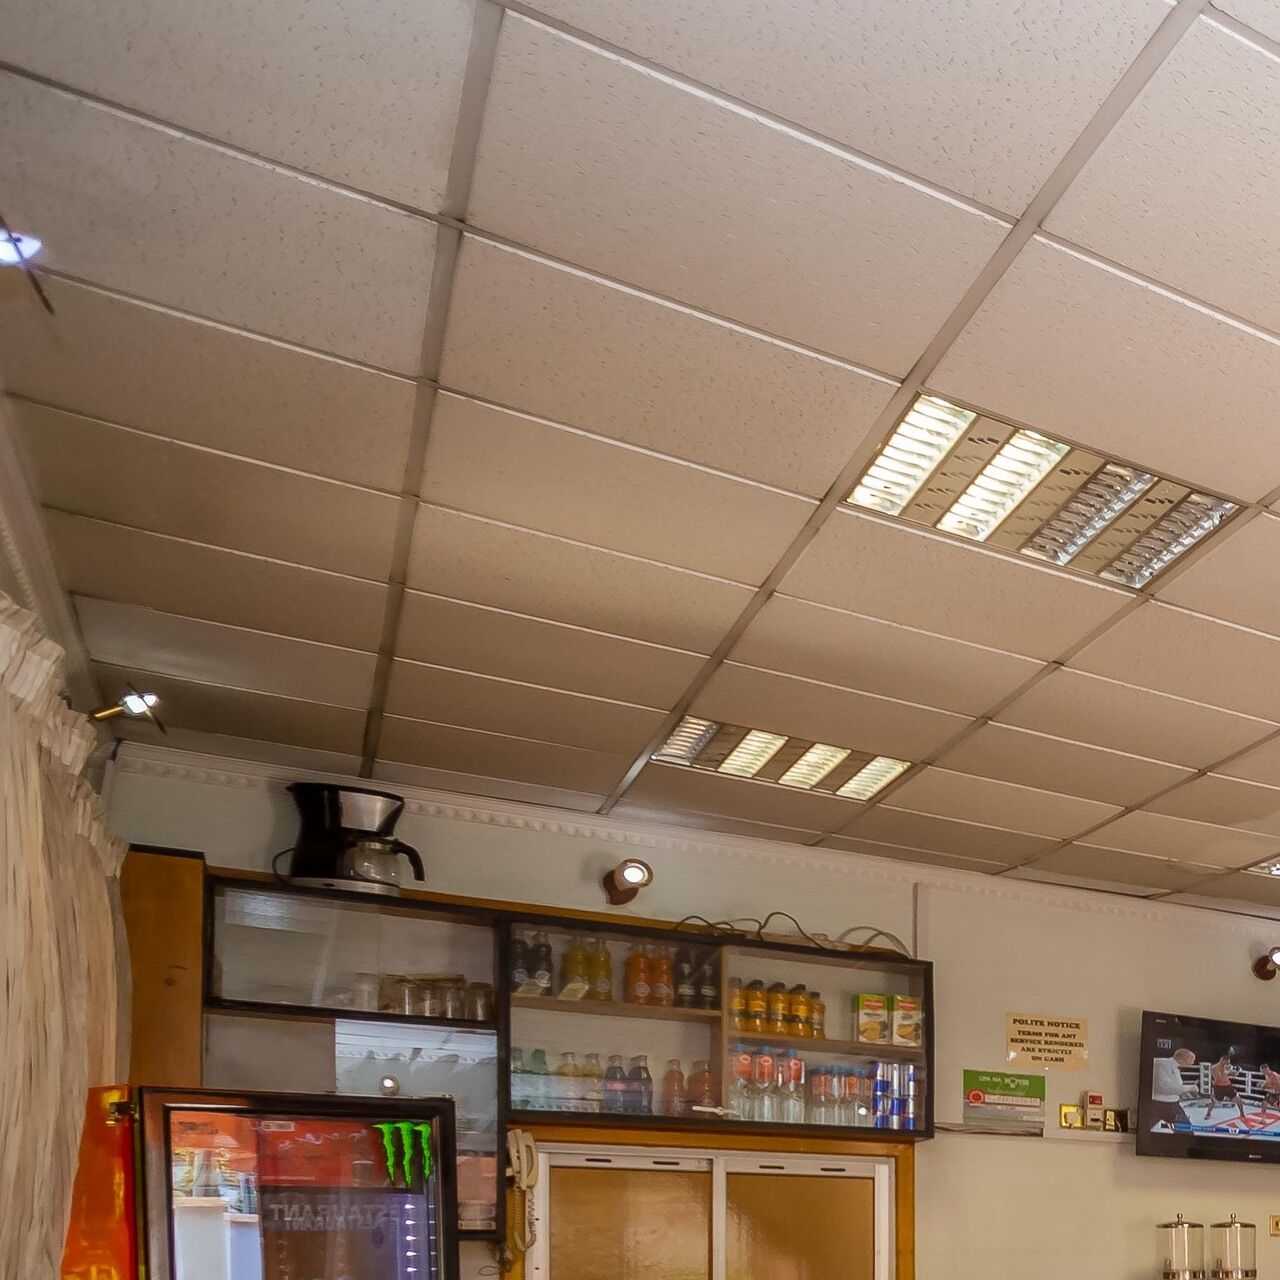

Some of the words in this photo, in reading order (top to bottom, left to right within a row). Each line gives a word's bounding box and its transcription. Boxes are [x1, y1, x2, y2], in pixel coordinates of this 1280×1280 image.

[1012, 1018, 1045, 1027] POLITE
[1047, 1020, 1081, 1030] NOTICE
[1044, 1040, 1084, 1048] RENDERED
